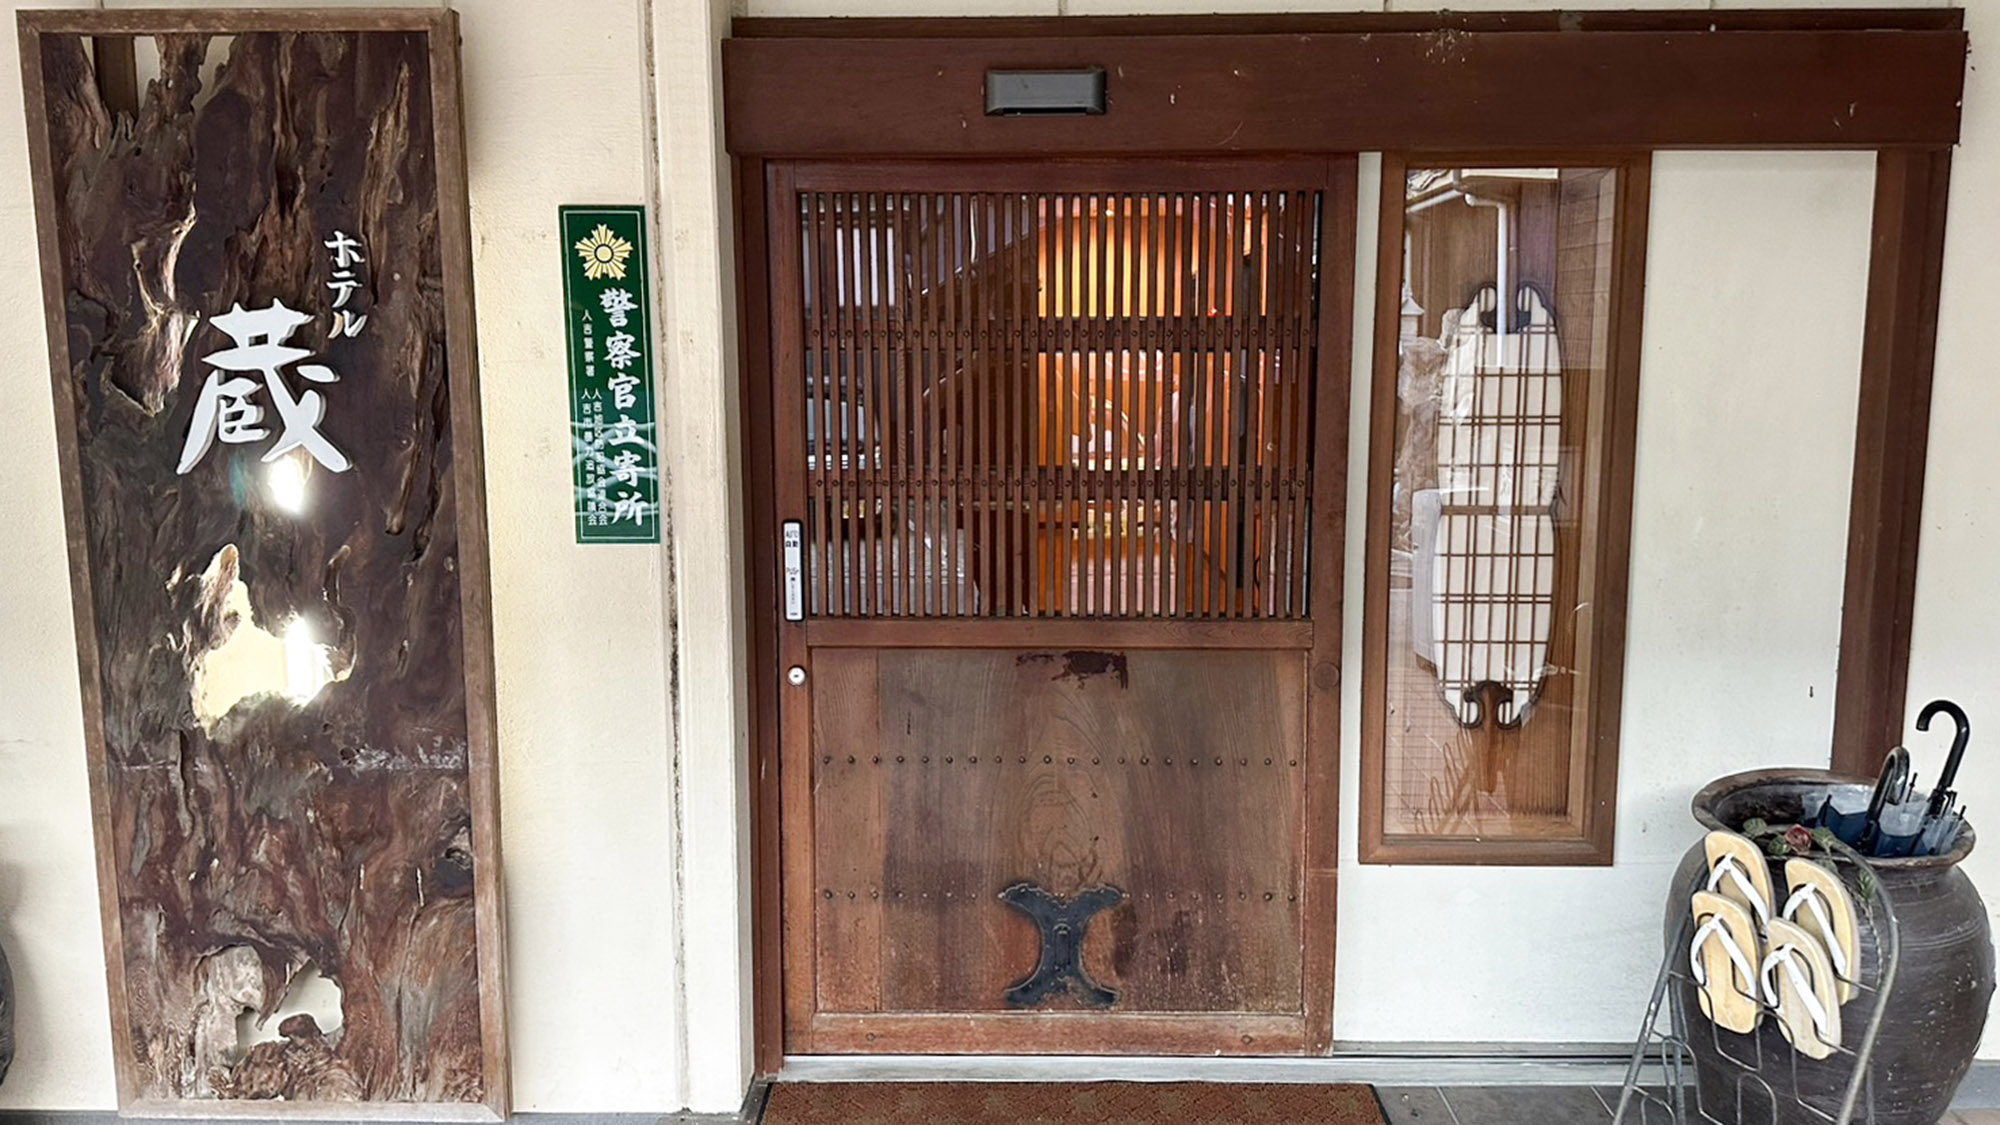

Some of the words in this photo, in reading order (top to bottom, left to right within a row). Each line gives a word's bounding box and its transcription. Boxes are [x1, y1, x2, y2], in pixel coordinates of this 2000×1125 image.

[324, 230, 368, 339] ホテル
[582, 309, 595, 377] 人吉警察署
[176, 298, 352, 474] 蔵
[599, 288, 647, 527] 警察官立寄所
